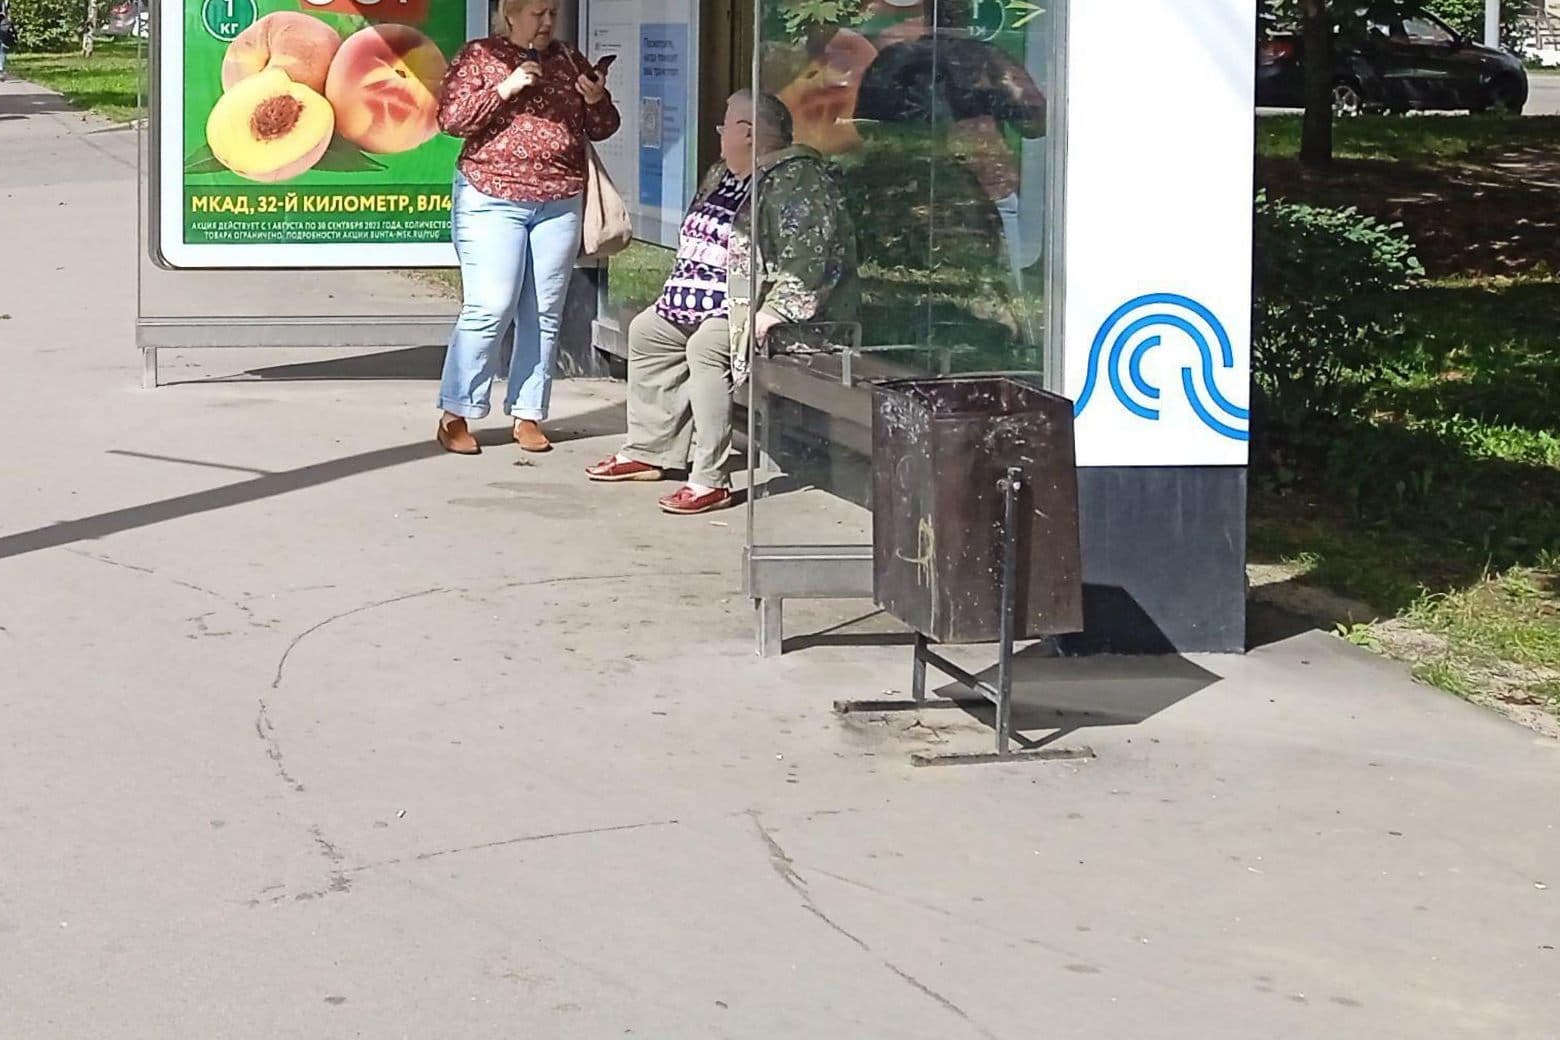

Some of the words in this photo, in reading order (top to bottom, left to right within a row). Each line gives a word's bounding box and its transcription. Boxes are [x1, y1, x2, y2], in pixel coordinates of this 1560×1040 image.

[220, 22, 239, 35] кг
[191, 195, 255, 215] МКАД,
[257, 191, 299, 213] 32-Й
[303, 194, 415, 215] КИЛОМЕТР,
[191, 221, 217, 231] АКЦИЯ
[218, 221, 260, 231] ДЕЙСТВУЕТ
[272, 221, 304, 231] АВГУСТА
[305, 221, 317, 231] ПО
[327, 221, 364, 231] СЕНТЯБРЯ
[204, 231, 233, 240] ТОВАРА
[286, 230, 341, 240] ПОДРОБНОСТИ
[342, 230, 369, 239] АКЦИИ
